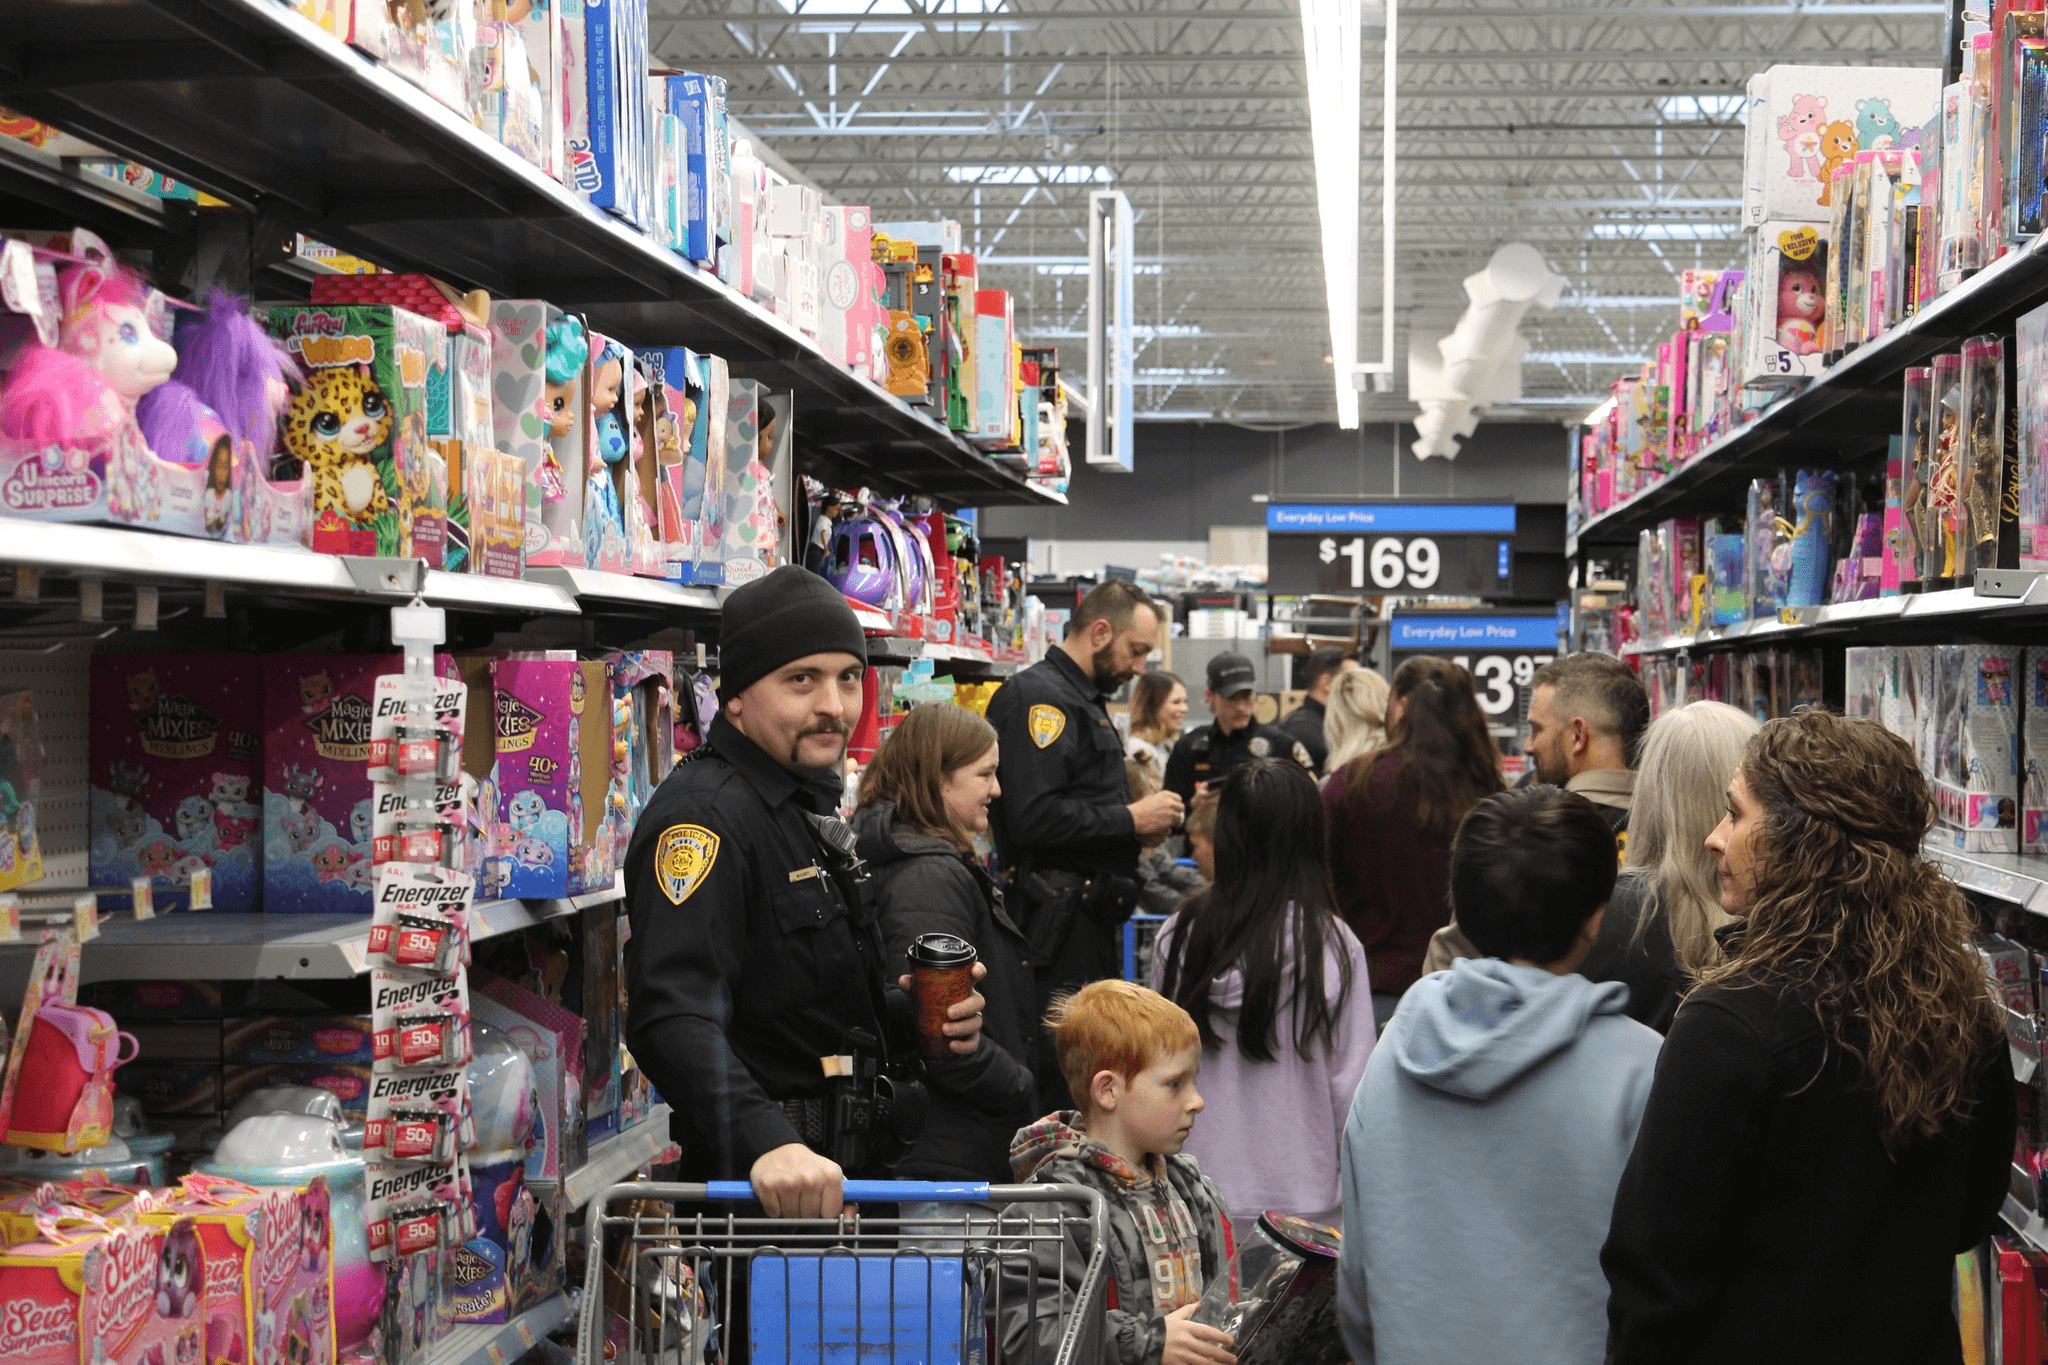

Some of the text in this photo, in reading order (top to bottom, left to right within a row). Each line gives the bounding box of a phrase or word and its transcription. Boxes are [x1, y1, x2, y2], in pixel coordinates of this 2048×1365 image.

[1783, 236, 1816, 251] EXCLUSIVE
[1778, 351, 1791, 373] 5
[1276, 511, 1375, 525] Everyday Low Price
[1402, 624, 1517, 641] Everyday Low Price
[529, 756, 559, 773] 40+
[671, 830, 705, 841] POLICE
[381, 884, 470, 907] Energizer
[372, 928, 387, 941] 10
[376, 978, 457, 1009] Energizer
[375, 1034, 390, 1047] 10
[373, 1072, 461, 1098] Energizer
[366, 1123, 382, 1136] 10
[371, 1224, 386, 1236] 10
[106, 1232, 151, 1295] Sew
[455, 1289, 496, 1315] reate?
[6, 1302, 69, 1336] Sew
